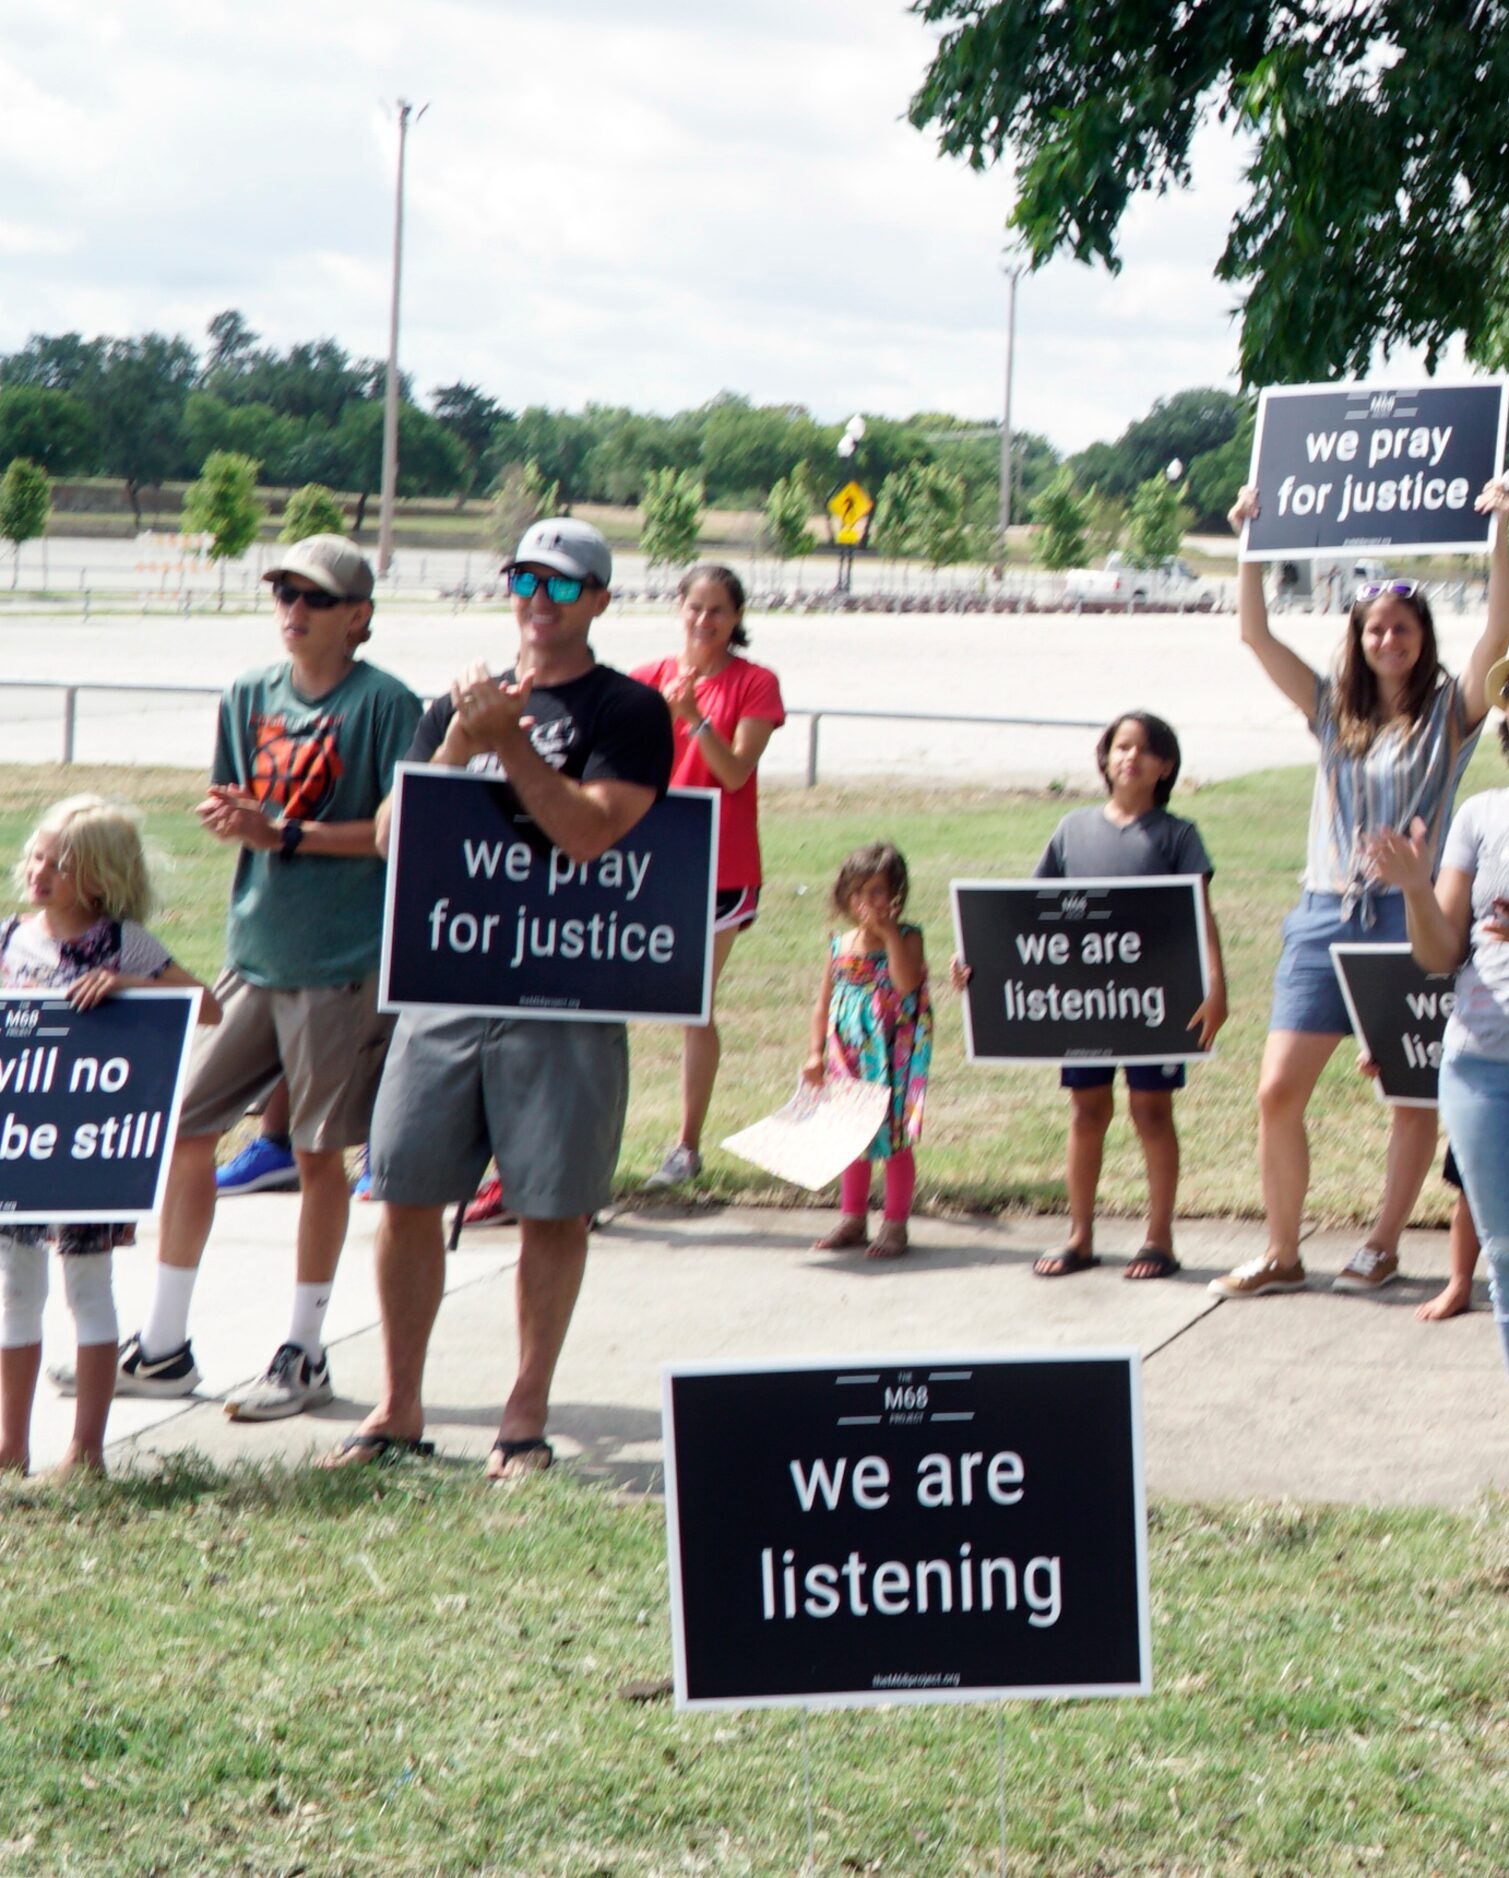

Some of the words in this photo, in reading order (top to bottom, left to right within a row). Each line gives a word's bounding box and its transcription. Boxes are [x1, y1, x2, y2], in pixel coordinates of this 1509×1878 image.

[1306, 430, 1360, 463] we
[1369, 426, 1453, 469] pray
[1278, 475, 1333, 516] for
[1337, 471, 1470, 522] justice
[463, 839, 532, 882] we
[429, 898, 500, 954] for
[510, 905, 676, 968] justice
[1015, 932, 1070, 965] we
[1081, 931, 1142, 965] are
[1004, 979, 1166, 1028] listening
[1405, 991, 1458, 1020] we
[69, 1057, 130, 1093] no
[0, 1112, 58, 1160] be
[71, 1111, 162, 1160] still
[884, 1385, 929, 1411] M68
[789, 1456, 890, 1511] we
[917, 1450, 1026, 1508] are
[761, 1542, 1063, 1629] listening
